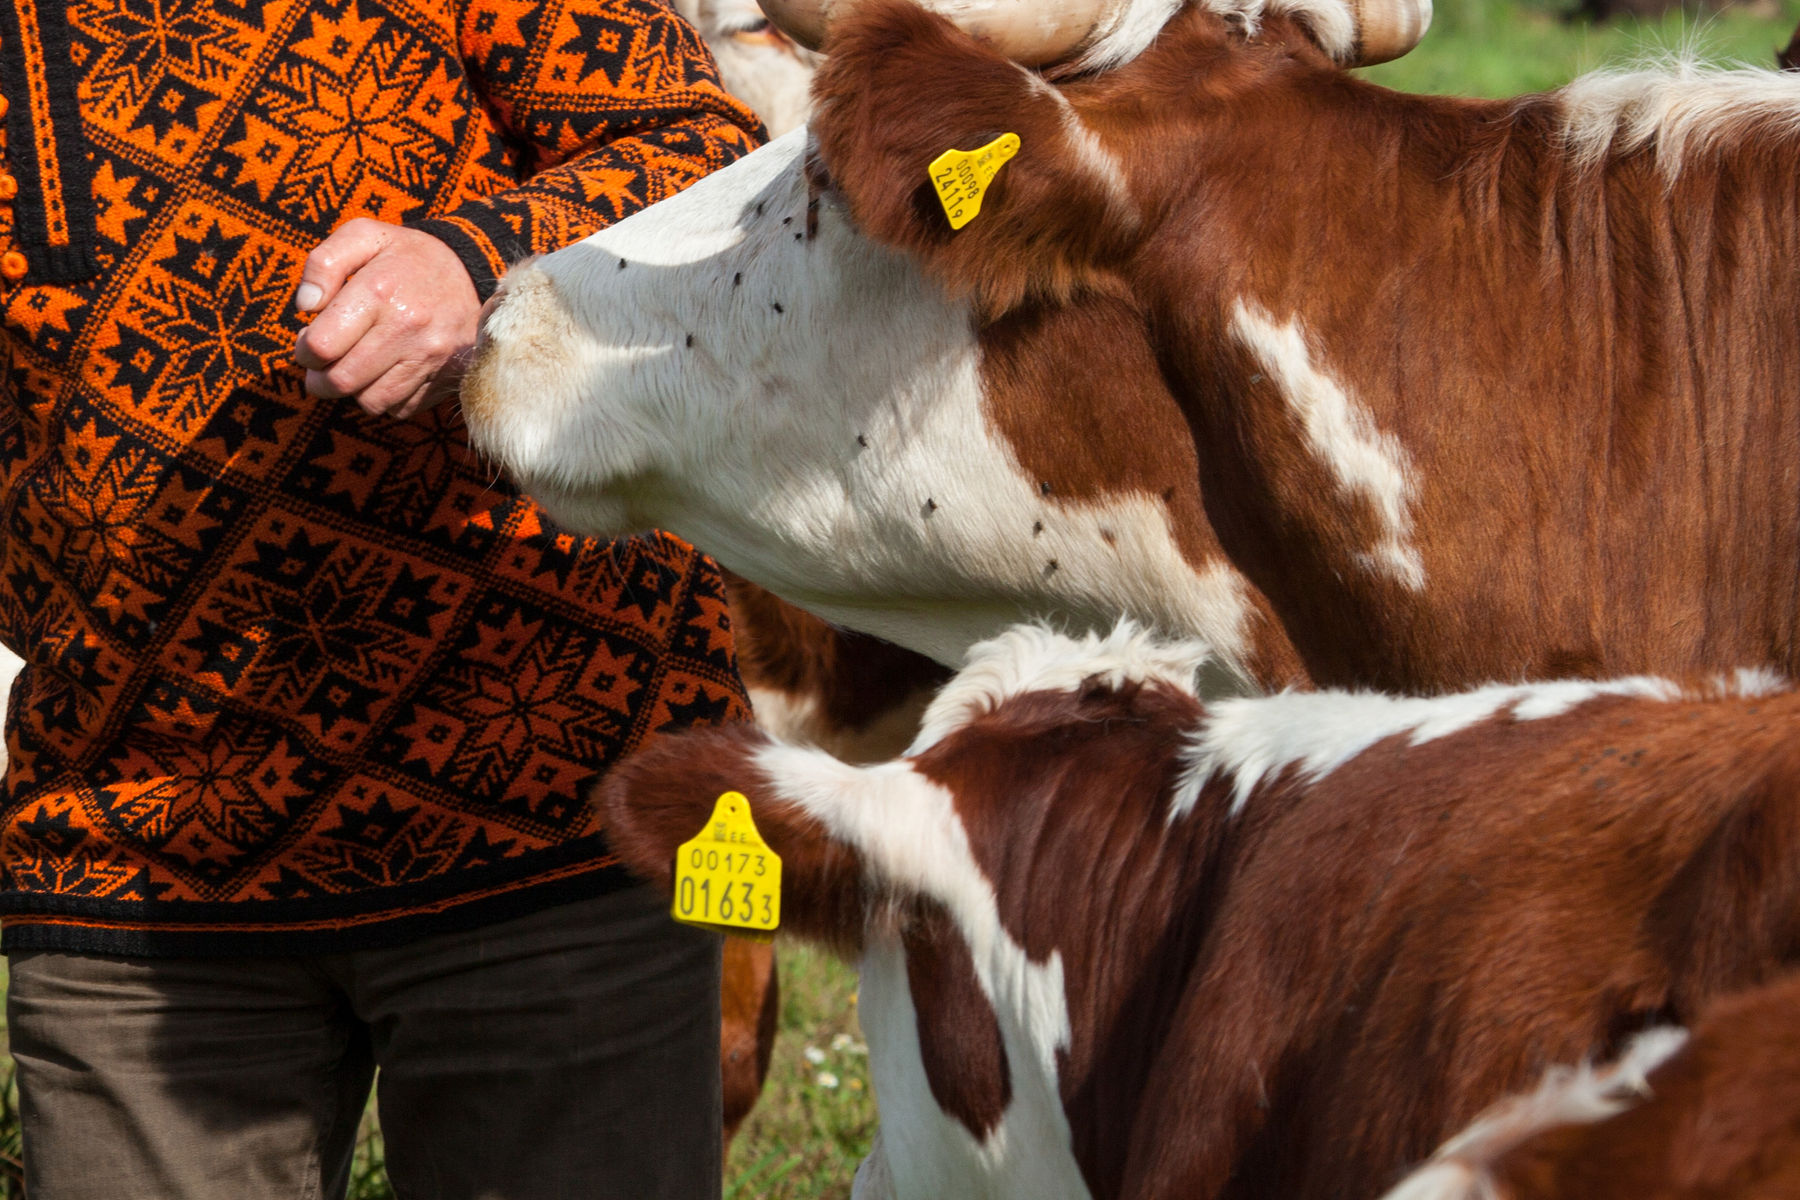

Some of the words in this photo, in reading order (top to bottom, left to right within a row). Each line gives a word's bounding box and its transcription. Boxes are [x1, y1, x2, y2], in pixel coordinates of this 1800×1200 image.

[935, 167, 965, 218] 24119
[956, 159, 980, 199] 00098
[730, 831, 747, 843] EE
[691, 848, 766, 877] 00173
[680, 876, 772, 924] 01633
